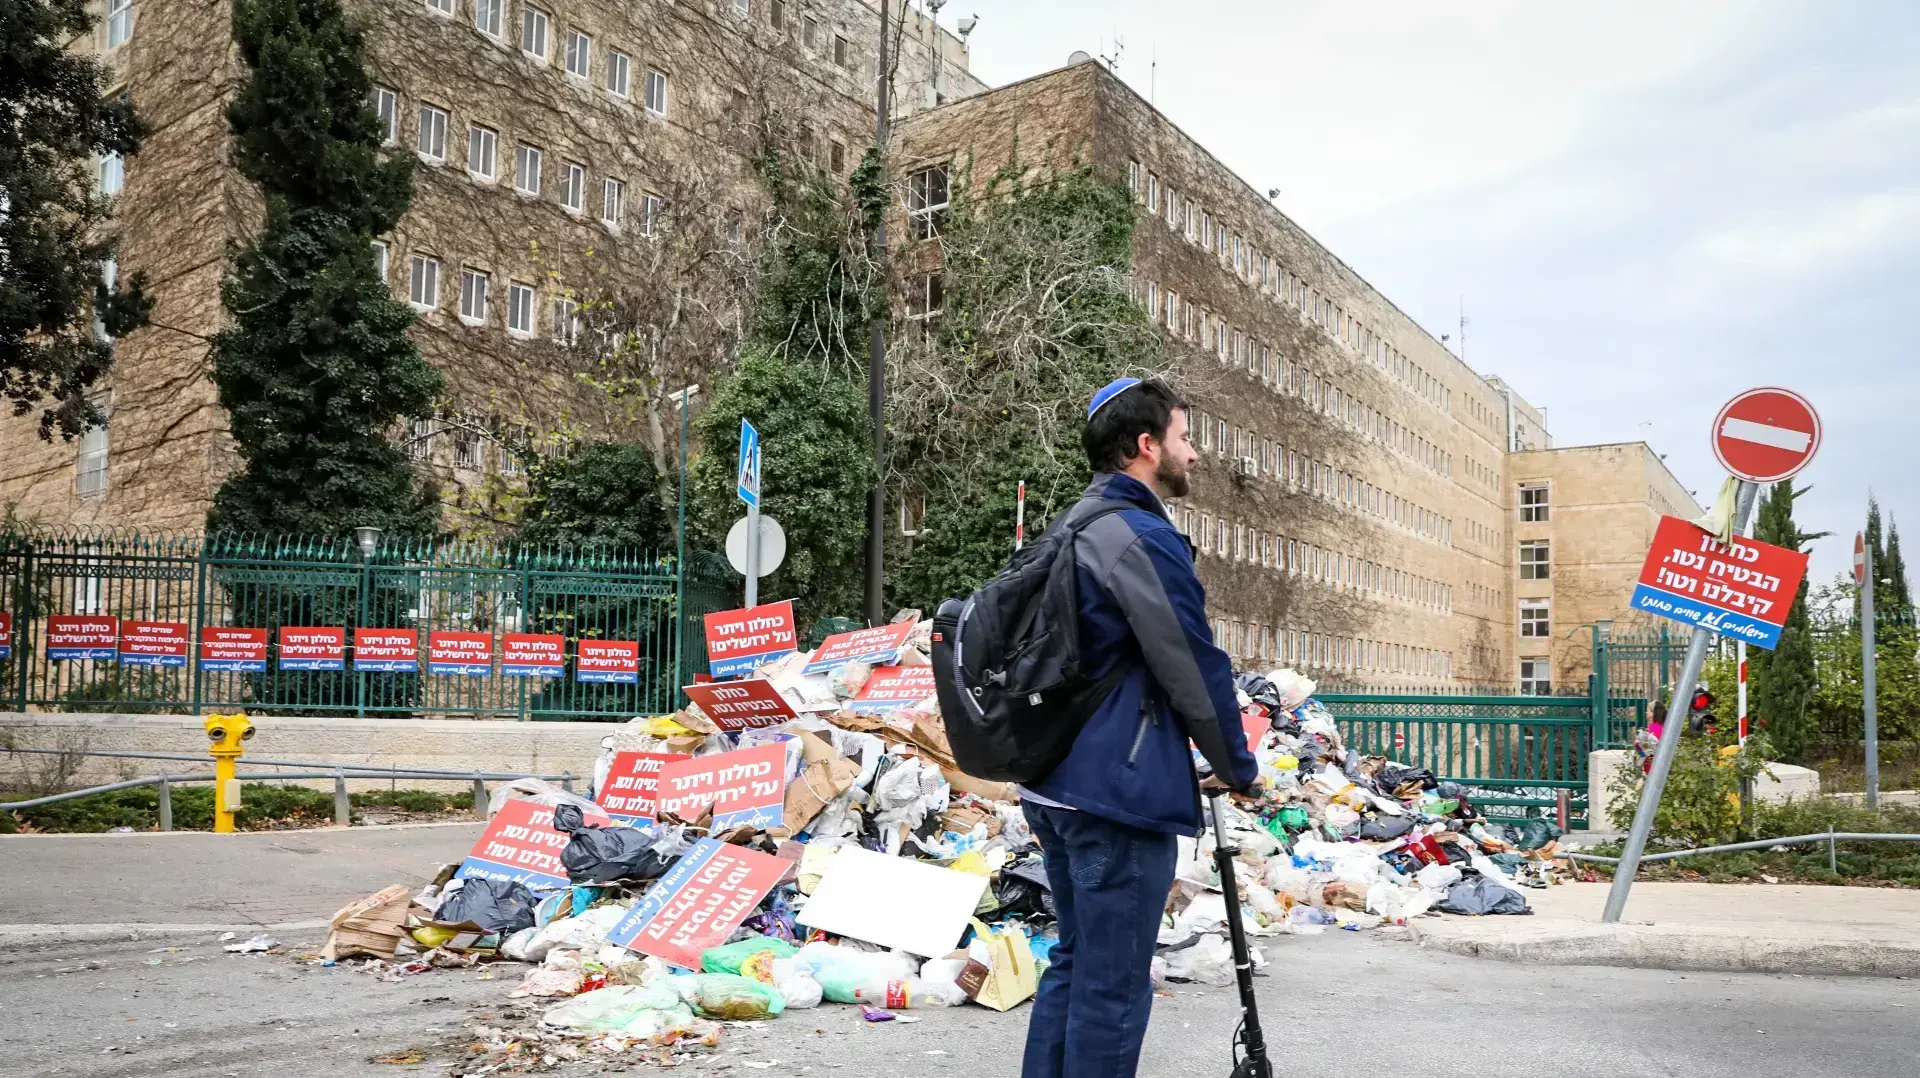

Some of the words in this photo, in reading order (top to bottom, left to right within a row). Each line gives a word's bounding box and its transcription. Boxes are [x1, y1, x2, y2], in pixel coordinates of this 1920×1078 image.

[1663, 548, 1706, 571] נטו,
[1656, 567, 1698, 593] וטו!
[1709, 560, 1780, 592] הבטיח
[1702, 582, 1774, 615] קיבלנו
[747, 616, 784, 633] כחלון
[1702, 612, 1730, 626] לא
[81, 623, 110, 633] כחלון
[714, 622, 745, 636] ויתר
[1722, 620, 1768, 640] ירושלמים
[51, 634, 98, 642] ירושלים!
[98, 634, 114, 642] על
[286, 634, 308, 643] ויתר
[310, 634, 338, 644] כחלון
[384, 636, 411, 646] כחלון
[711, 634, 770, 652] ירושלים!
[772, 630, 792, 643] על
[282, 644, 326, 654] ירושלים!
[327, 644, 341, 654] על
[356, 646, 400, 655] ירושלים!
[400, 646, 415, 656] על
[459, 640, 486, 650] כחלון
[532, 642, 558, 651] כחלון
[432, 649, 474, 659] ירושלים!
[475, 650, 489, 660] על
[504, 650, 546, 660] ירושלים!
[548, 652, 561, 661] על
[606, 648, 632, 658] כחלון
[580, 657, 621, 666] ירושלים!
[622, 658, 636, 668] על
[904, 678, 936, 686] טיח
[711, 687, 750, 701] כחלון
[733, 700, 780, 712] הבטיח
[718, 761, 772, 786] כחלון
[633, 778, 659, 792] טיח
[671, 772, 714, 790] ויתר
[751, 780, 779, 797] על
[602, 794, 626, 809] וטו!
[625, 796, 656, 816] יבלנו
[660, 785, 747, 813] ירושלים!
[528, 810, 554, 826] לון
[495, 824, 531, 840] נטו,
[530, 829, 570, 848] בטיח
[484, 840, 518, 860] וטו!
[648, 886, 704, 940] קיבלנו
[696, 855, 736, 885] וטו!
[710, 886, 759, 932] כחלון
[668, 893, 726, 947] הבטיח
